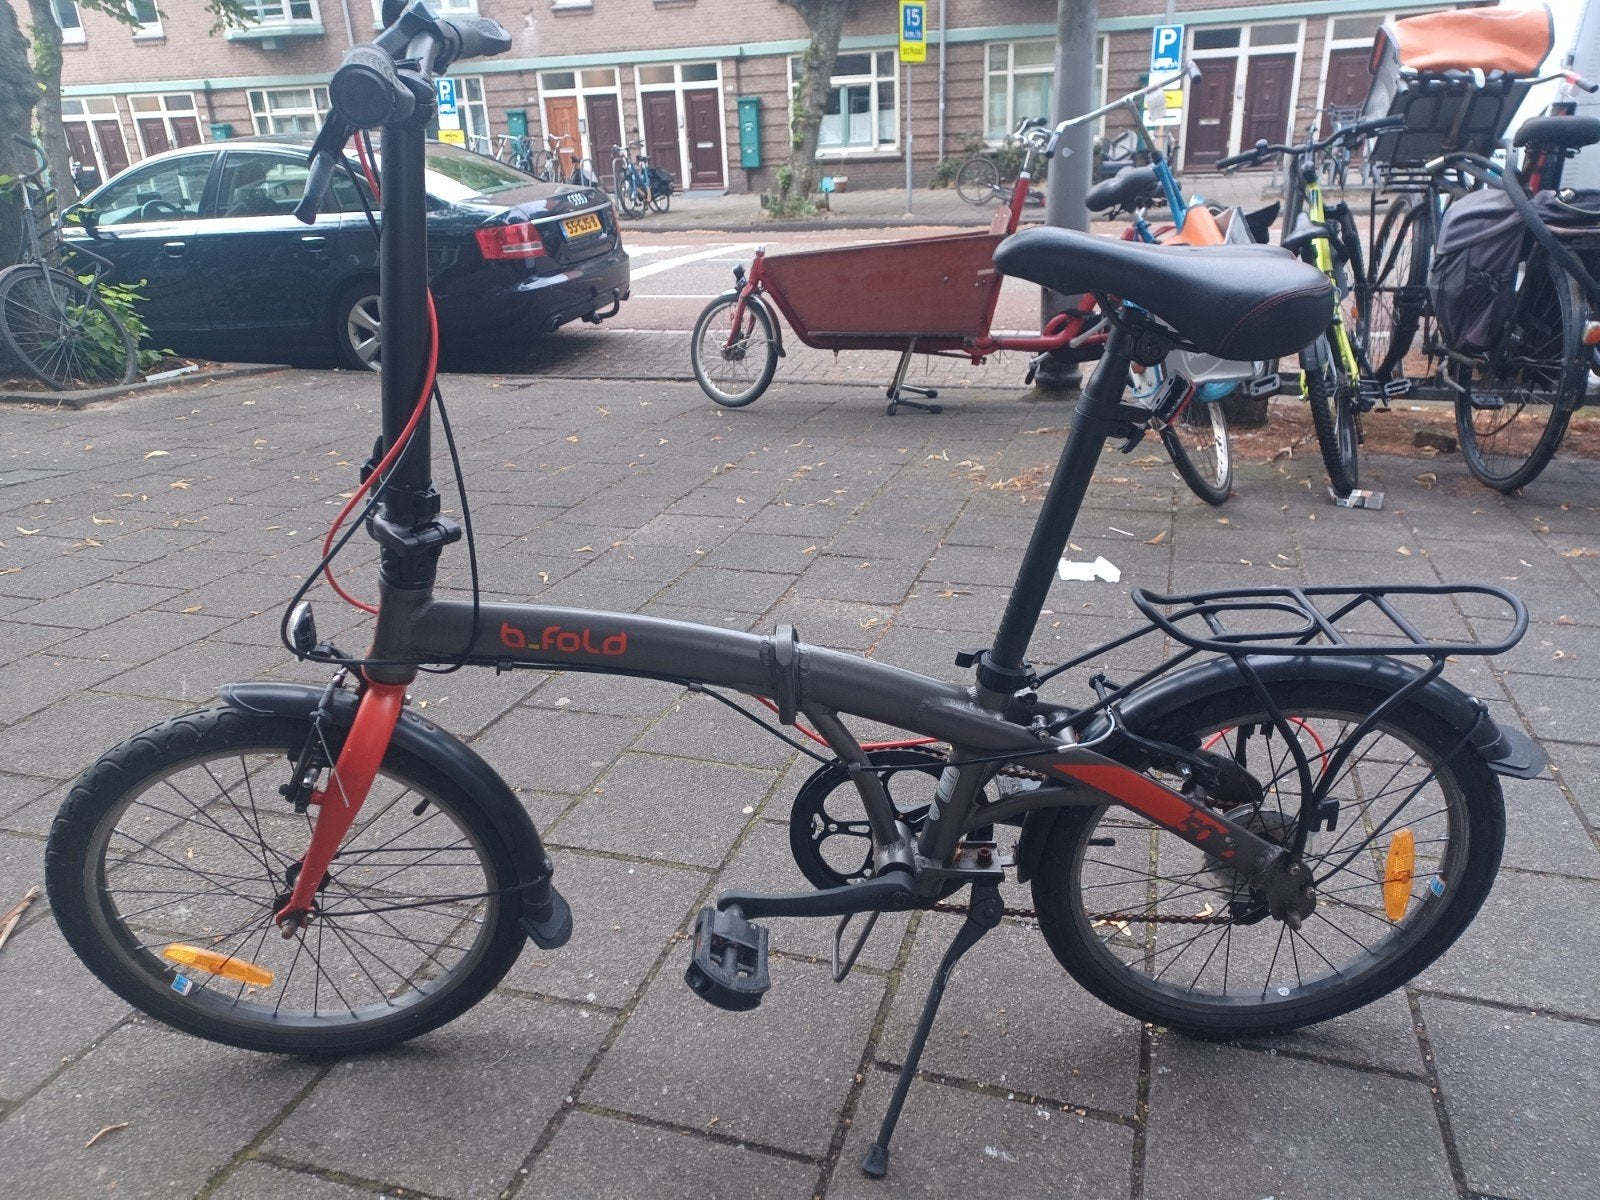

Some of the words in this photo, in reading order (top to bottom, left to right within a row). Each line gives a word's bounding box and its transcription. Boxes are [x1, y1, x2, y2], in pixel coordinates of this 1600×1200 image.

[905, 8, 921, 27] 15
[904, 29, 922, 39] km/h
[1158, 28, 1178, 54] P
[438, 80, 451, 101] P
